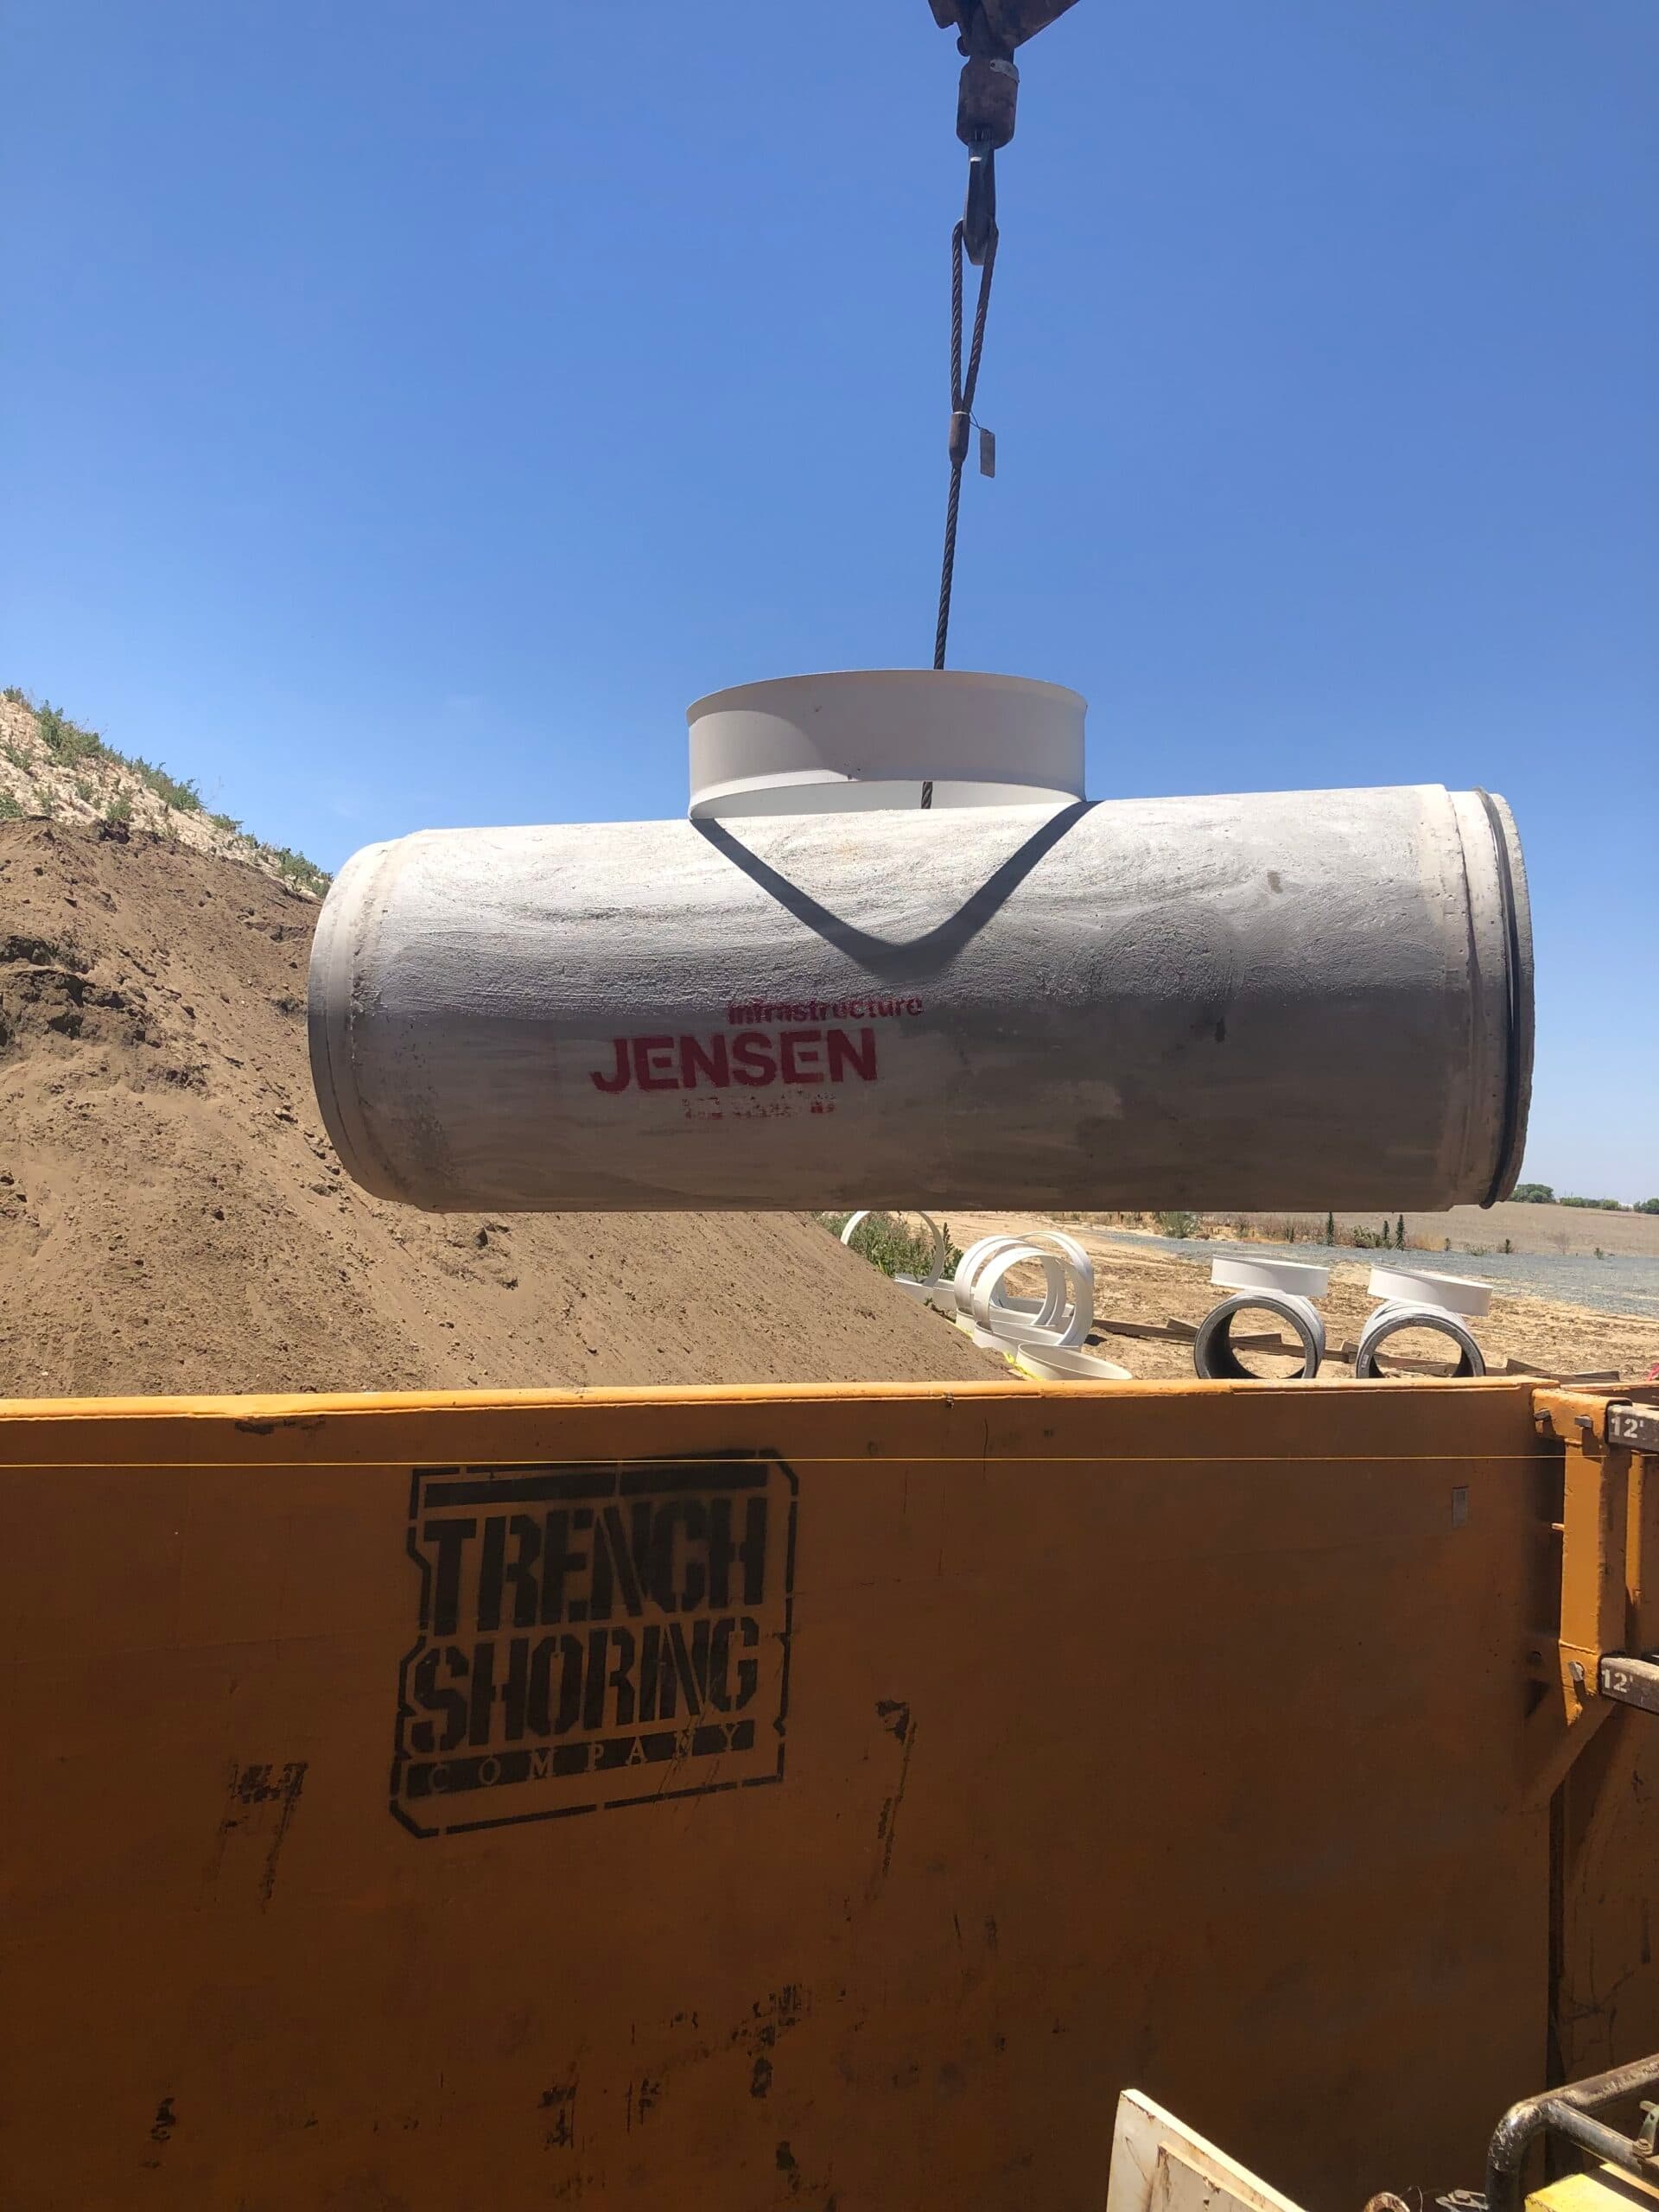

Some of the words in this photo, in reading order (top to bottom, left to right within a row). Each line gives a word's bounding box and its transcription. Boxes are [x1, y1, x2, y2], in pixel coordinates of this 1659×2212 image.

[590, 1027, 878, 1092] JENSEN
[423, 1497, 769, 1637] TRENCH
[411, 1617, 760, 1753] SHORING
[427, 1722, 741, 1791] COMPANY
